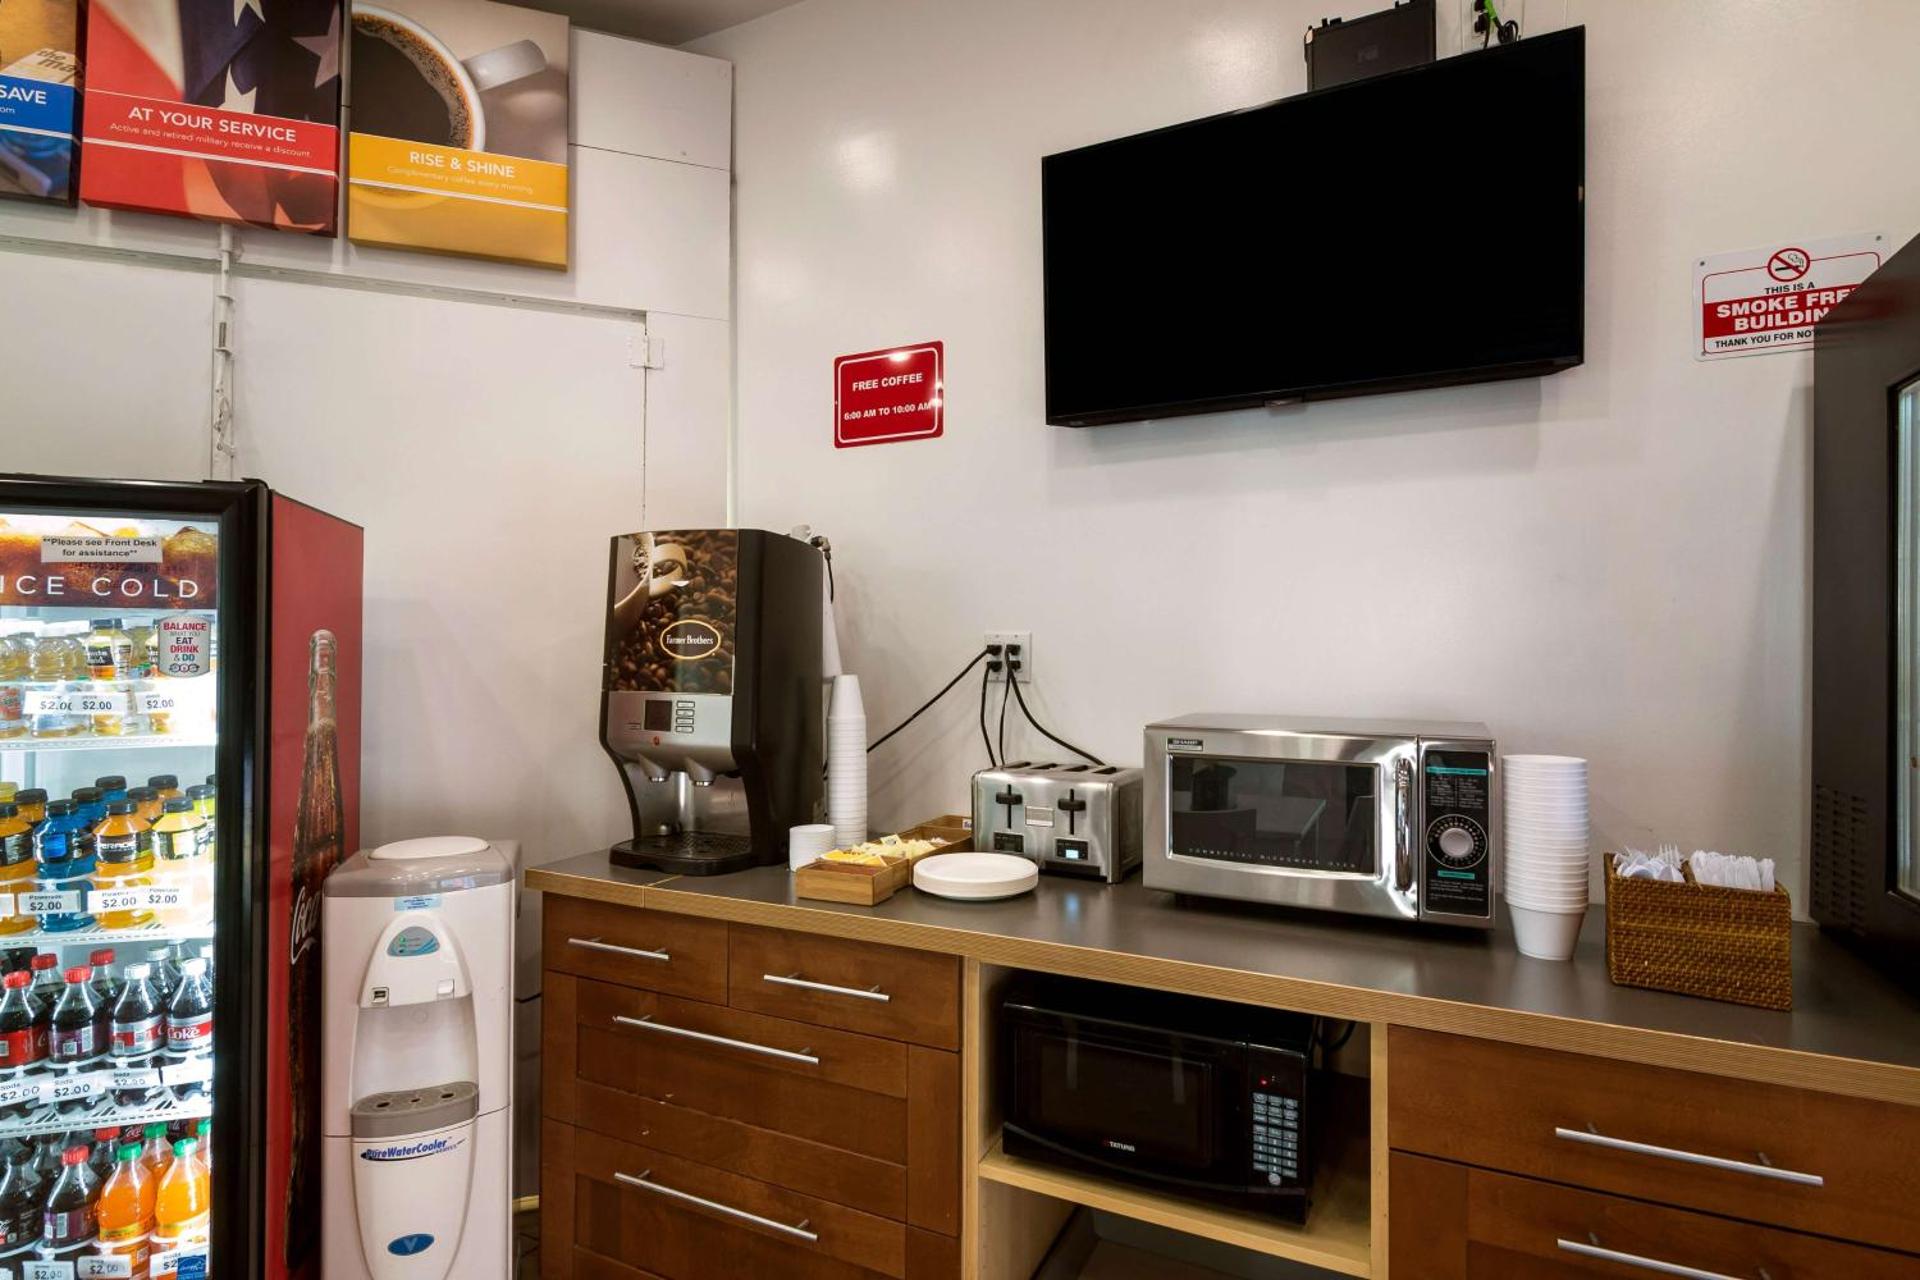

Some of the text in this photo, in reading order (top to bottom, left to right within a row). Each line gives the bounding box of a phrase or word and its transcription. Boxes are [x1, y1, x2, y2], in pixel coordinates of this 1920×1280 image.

[0, 84, 48, 105] SAVE
[127, 106, 297, 143] AT YOUR SERVICE
[110, 122, 140, 135] Active
[143, 128, 161, 137] and
[163, 130, 193, 142] retired
[195, 134, 229, 148] military
[231, 141, 263, 151] receive
[409, 151, 516, 178] RISE & SHINE
[1765, 281, 1816, 295] THIS IS A
[1716, 287, 1857, 318] SMOKE FRE
[1715, 337, 1748, 348] THANK
[1750, 334, 1771, 345] YOU
[1774, 331, 1794, 342] FOR
[852, 372, 923, 392] FREE COFFEE
[863, 408, 877, 419] AM
[878, 406, 890, 416] TO
[893, 403, 916, 415] 10:00
[85, 539, 102, 547] see
[105, 538, 131, 548] Front
[133, 539, 157, 547] Desk
[62, 548, 76, 557] for
[0, 575, 199, 598] ICE COLD
[163, 622, 207, 631] BALANCE
[176, 637, 193, 645] EAT
[170, 645, 199, 653] DRINK
[82, 700, 112, 710] $2.00
[146, 699, 174, 710] $2.00
[30, 902, 62, 911] $2.00
[102, 897, 137, 909] $2.00
[148, 895, 178, 904] $2.00
[0, 1086, 40, 1100] $2.00
[54, 1083, 91, 1098] $2.00
